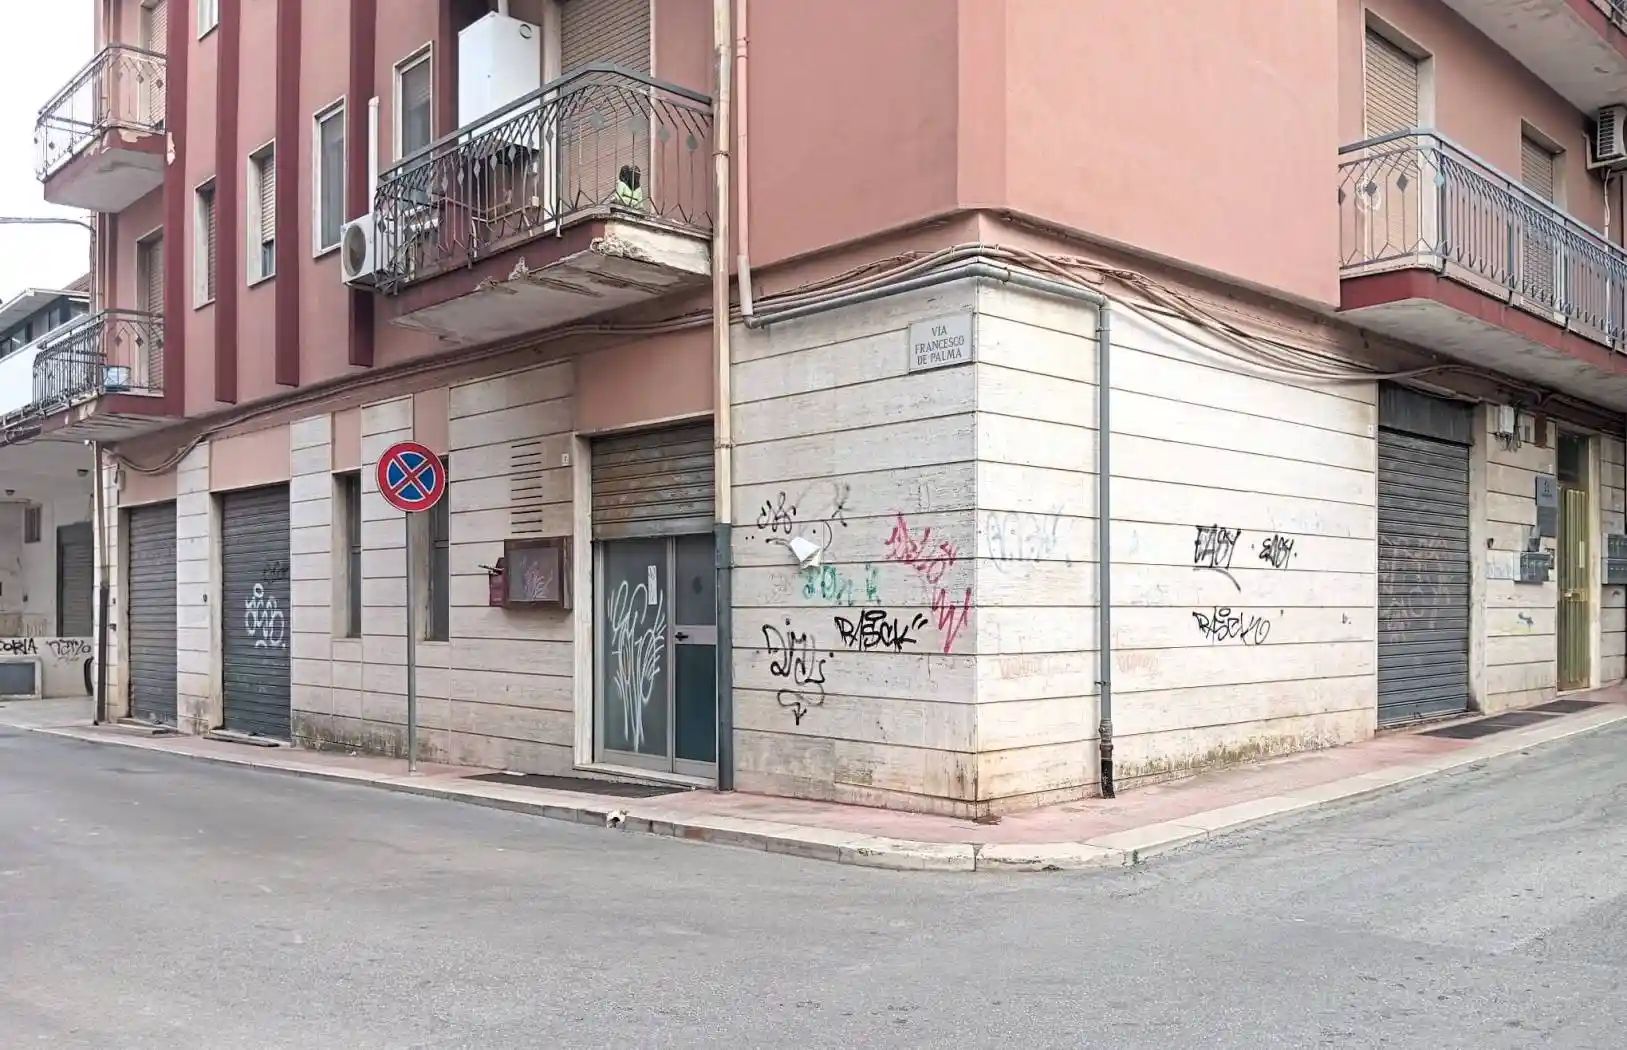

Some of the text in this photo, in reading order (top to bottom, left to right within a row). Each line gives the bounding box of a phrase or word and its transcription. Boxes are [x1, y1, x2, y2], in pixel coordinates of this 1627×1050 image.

[931, 324, 947, 336] VIA
[915, 335, 965, 354] FRANCESCO
[917, 347, 962, 365] DE PALMA
